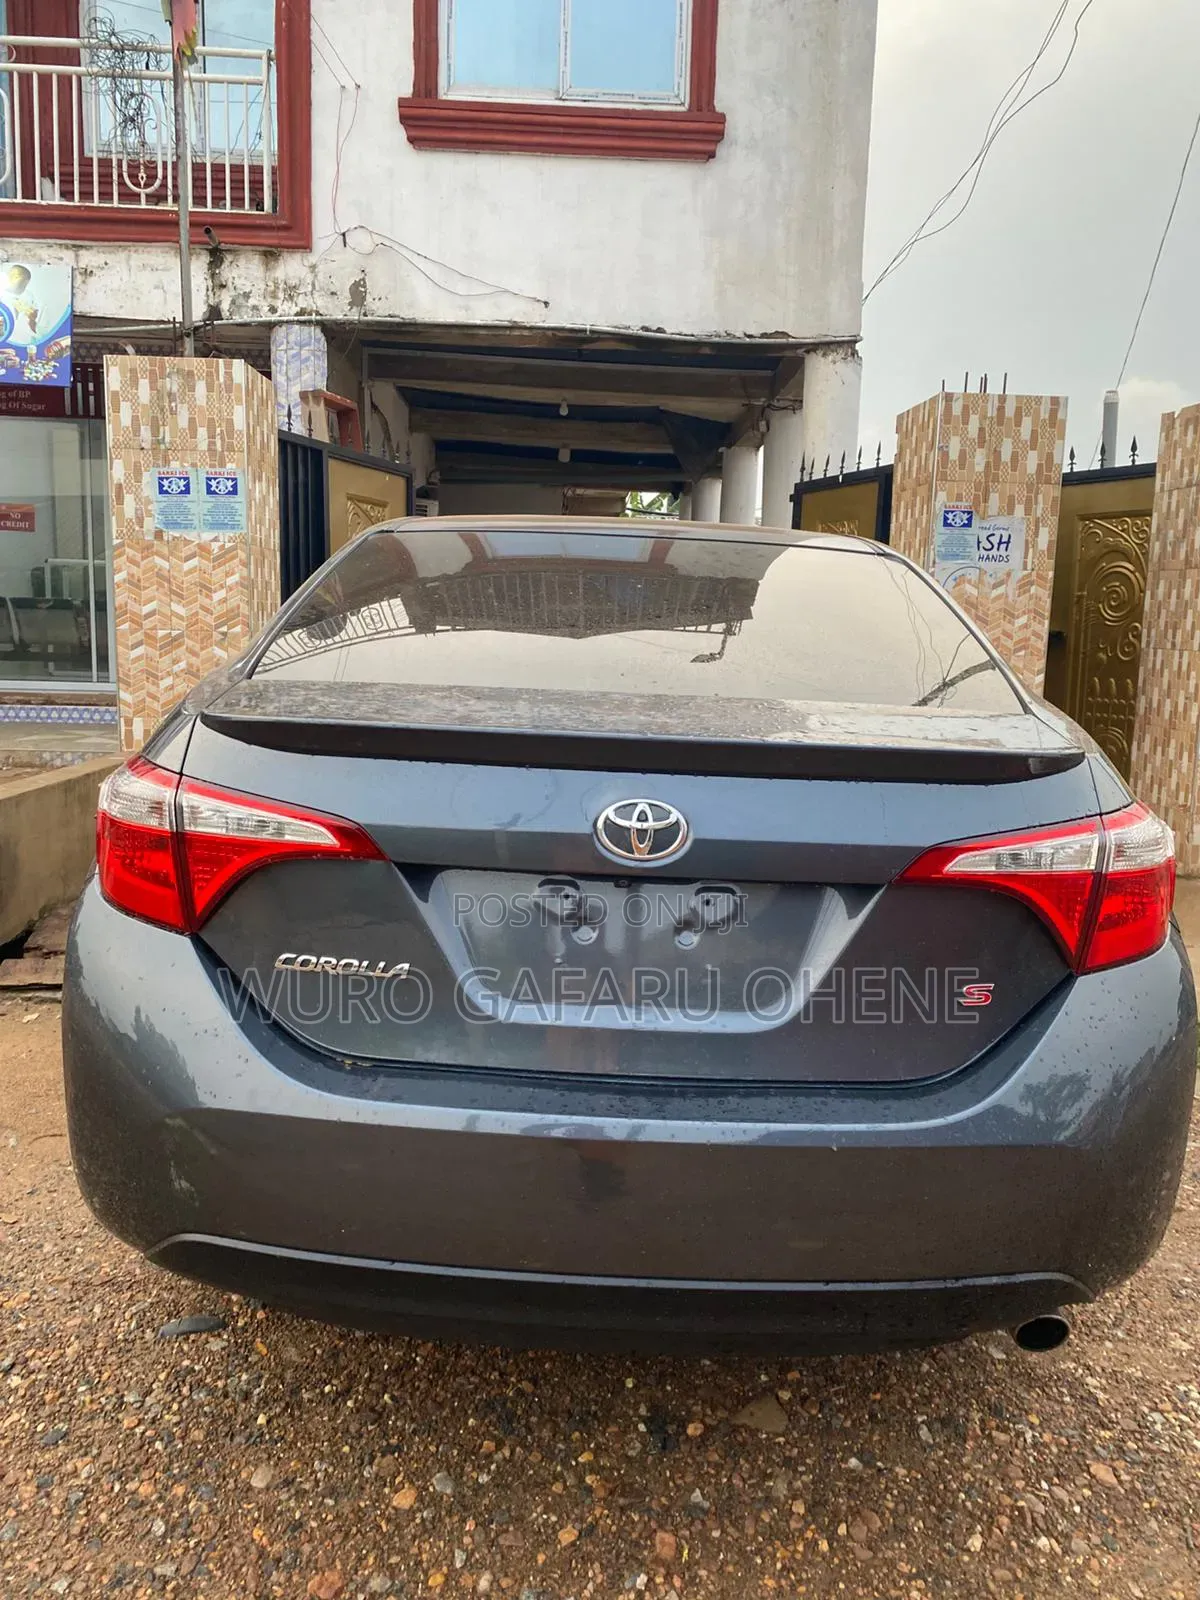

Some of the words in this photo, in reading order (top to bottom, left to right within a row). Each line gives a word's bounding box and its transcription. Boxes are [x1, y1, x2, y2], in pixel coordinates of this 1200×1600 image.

[10, 511, 21, 519] NO
[0, 520, 29, 528] CREDIT
[977, 553, 1010, 563] HANDS
[274, 952, 411, 979] COROLLA
[957, 983, 995, 1006] S
